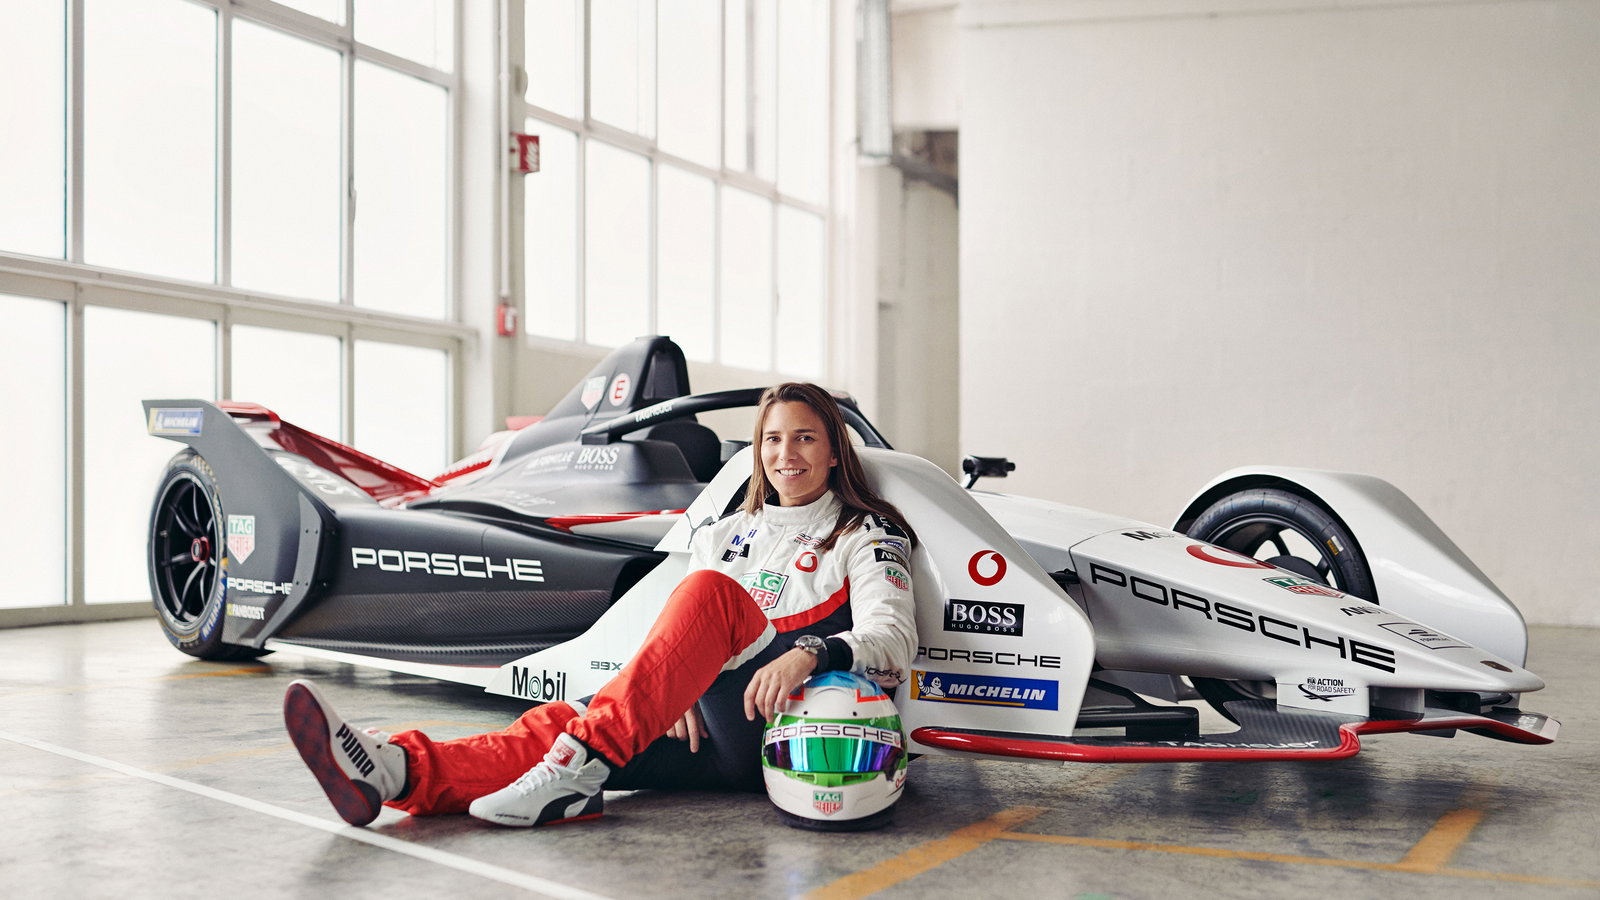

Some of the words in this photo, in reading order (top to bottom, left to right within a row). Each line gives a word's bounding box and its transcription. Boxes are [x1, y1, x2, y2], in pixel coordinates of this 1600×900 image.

[577, 447, 619, 464] BOSS
[230, 519, 253, 534] TAG
[351, 547, 545, 582] PORSCHE
[227, 577, 293, 594] PORSCHE
[952, 603, 1016, 626] BOSS
[1090, 562, 1395, 674] PORSCHE
[951, 623, 980, 631] HUGO
[512, 665, 566, 701] Mobil
[1317, 678, 1344, 687] ACTION
[1317, 685, 1332, 693] ROAD
[948, 683, 1046, 701] MICHELIN
[770, 725, 894, 742] PORSCHE
[335, 722, 375, 778] PUMA
